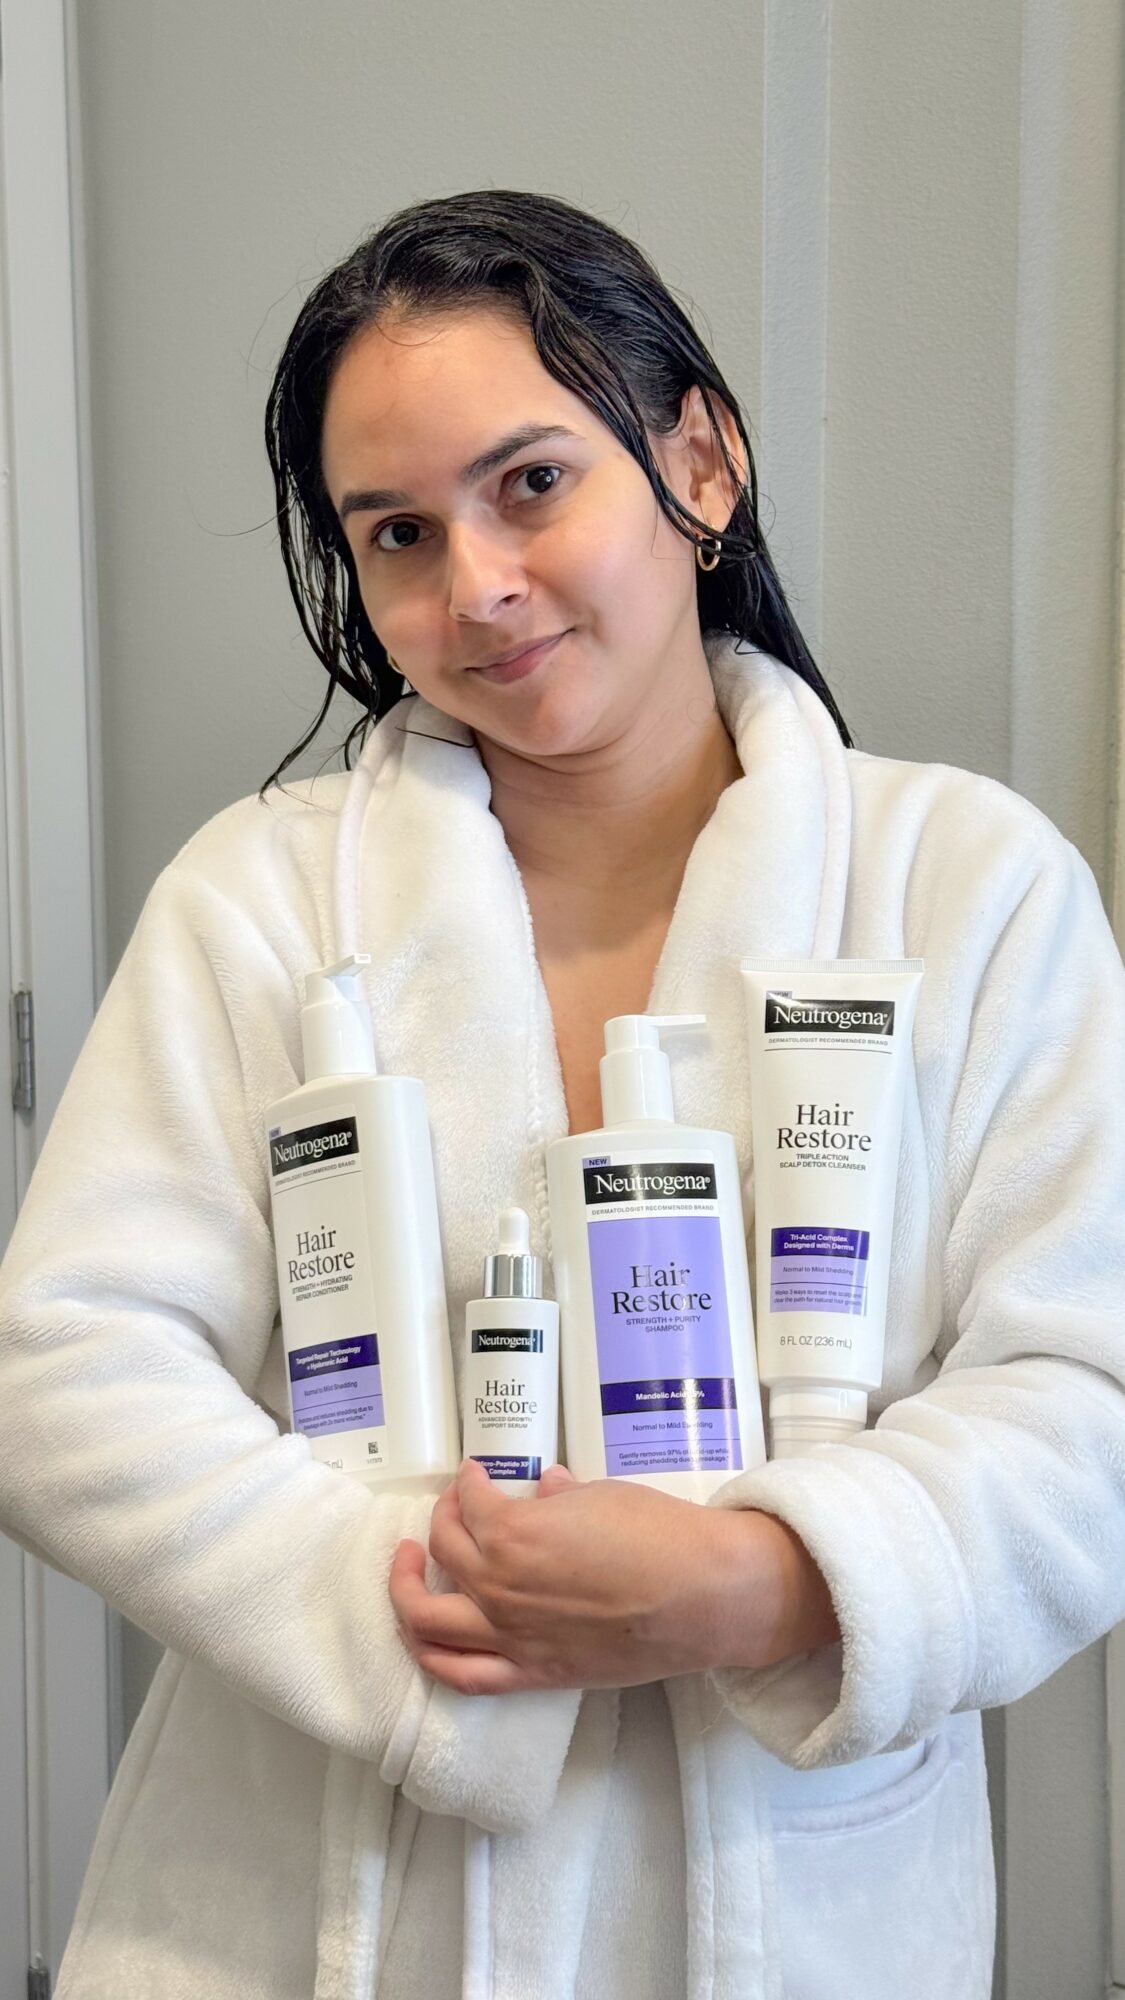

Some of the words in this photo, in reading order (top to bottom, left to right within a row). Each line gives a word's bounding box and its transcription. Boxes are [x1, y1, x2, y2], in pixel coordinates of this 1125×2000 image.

[795, 1103, 855, 1126] Hair
[776, 1127, 872, 1152] Restore
[589, 1158, 607, 1166] NEW
[828, 1161, 866, 1171] CLEANSER
[591, 1206, 644, 1215] DERMATOLOGIST
[296, 1225, 336, 1256] Hair
[817, 1234, 848, 1243] Complex
[783, 1242, 816, 1250] Designed
[831, 1242, 855, 1251] Derms
[288, 1251, 356, 1283] Restore
[826, 1267, 854, 1276] Shedding
[630, 1262, 691, 1288] Hair
[320, 1275, 353, 1286] HYDRATING
[312, 1284, 349, 1298] CONDITIONER
[611, 1289, 712, 1314] Restore
[626, 1316, 667, 1325] STRENGTH
[674, 1315, 701, 1323] PURITY
[645, 1325, 684, 1333] SHAMPOO
[780, 1336, 786, 1346] 8
[787, 1336, 797, 1346] FL
[798, 1336, 813, 1346] OZ
[814, 1336, 834, 1347] (236
[836, 1336, 852, 1349] mL)
[330, 1346, 361, 1356] Technology
[336, 1356, 349, 1364] Acid
[334, 1381, 358, 1390] Shedding
[485, 1379, 525, 1396] Hair
[635, 1391, 669, 1400] Mandelic
[475, 1397, 537, 1414] Restore
[682, 1421, 713, 1429] Sding
[619, 1452, 639, 1460] Gently
[621, 1459, 648, 1467] reducing
[489, 1468, 517, 1476] Complex
